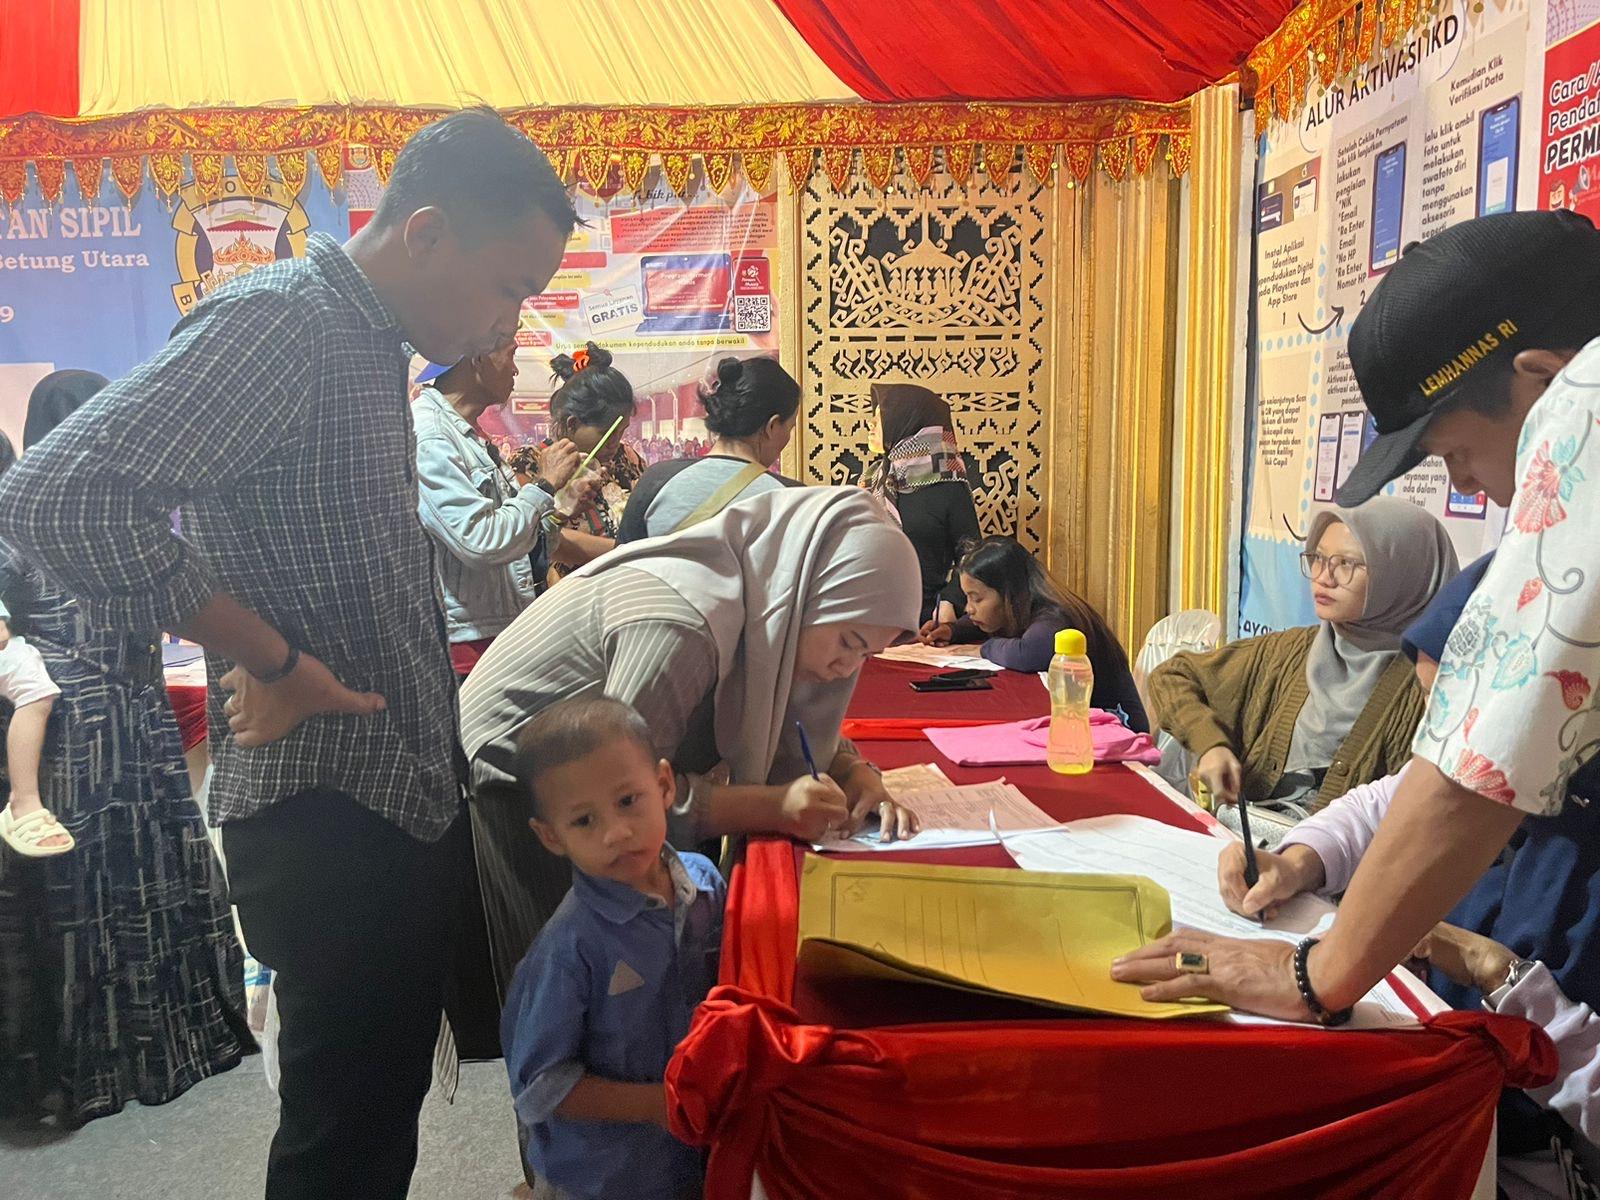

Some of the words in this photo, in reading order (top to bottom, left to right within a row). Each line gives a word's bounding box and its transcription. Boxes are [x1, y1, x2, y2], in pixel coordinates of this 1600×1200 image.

[1306, 88, 1344, 131] ALUR
[1348, 38, 1421, 106] AKTIVASI
[1426, 14, 1459, 57] IKD
[1451, 67, 1486, 92] Kemudian
[1488, 54, 1503, 71] Klik
[1449, 79, 1483, 106] Verifikasi
[1485, 72, 1504, 88] Data
[1425, 129, 1438, 144] lalu
[1441, 121, 1453, 137] klik
[1455, 109, 1475, 130] ambil
[1424, 145, 1439, 158] foto
[1441, 133, 1461, 150] untuk
[1423, 148, 1464, 171] melakukan
[1336, 166, 1361, 185] lakukan
[1423, 168, 1453, 186] swafoto
[1454, 159, 1467, 173] diri
[1335, 178, 1366, 202] pengisian
[1422, 183, 1445, 198] tanpa
[1422, 186, 1473, 212] menggunakan
[0, 207, 49, 240] AN
[59, 206, 142, 239] SIPIL
[1422, 205, 1455, 225] aksesoris
[1349, 220, 1365, 233] Enter
[1339, 232, 1356, 250] Email
[81, 249, 150, 268] Utara
[1347, 248, 1356, 261] HP
[1346, 263, 1363, 276] Enter
[1357, 271, 1367, 285] HP
[1267, 297, 1281, 309] App
[1282, 293, 1298, 303] Store
[1360, 289, 1366, 306] 2
[591, 303, 639, 324] GRATIS
[628, 339, 677, 349] kependudukan
[678, 338, 695, 347] anda
[696, 338, 715, 348] tanpa
[716, 337, 745, 345] berwakil
[1419, 333, 1499, 396] LEMHANNAS
[1497, 319, 1518, 339] RI
[1416, 482, 1437, 494] dalam
